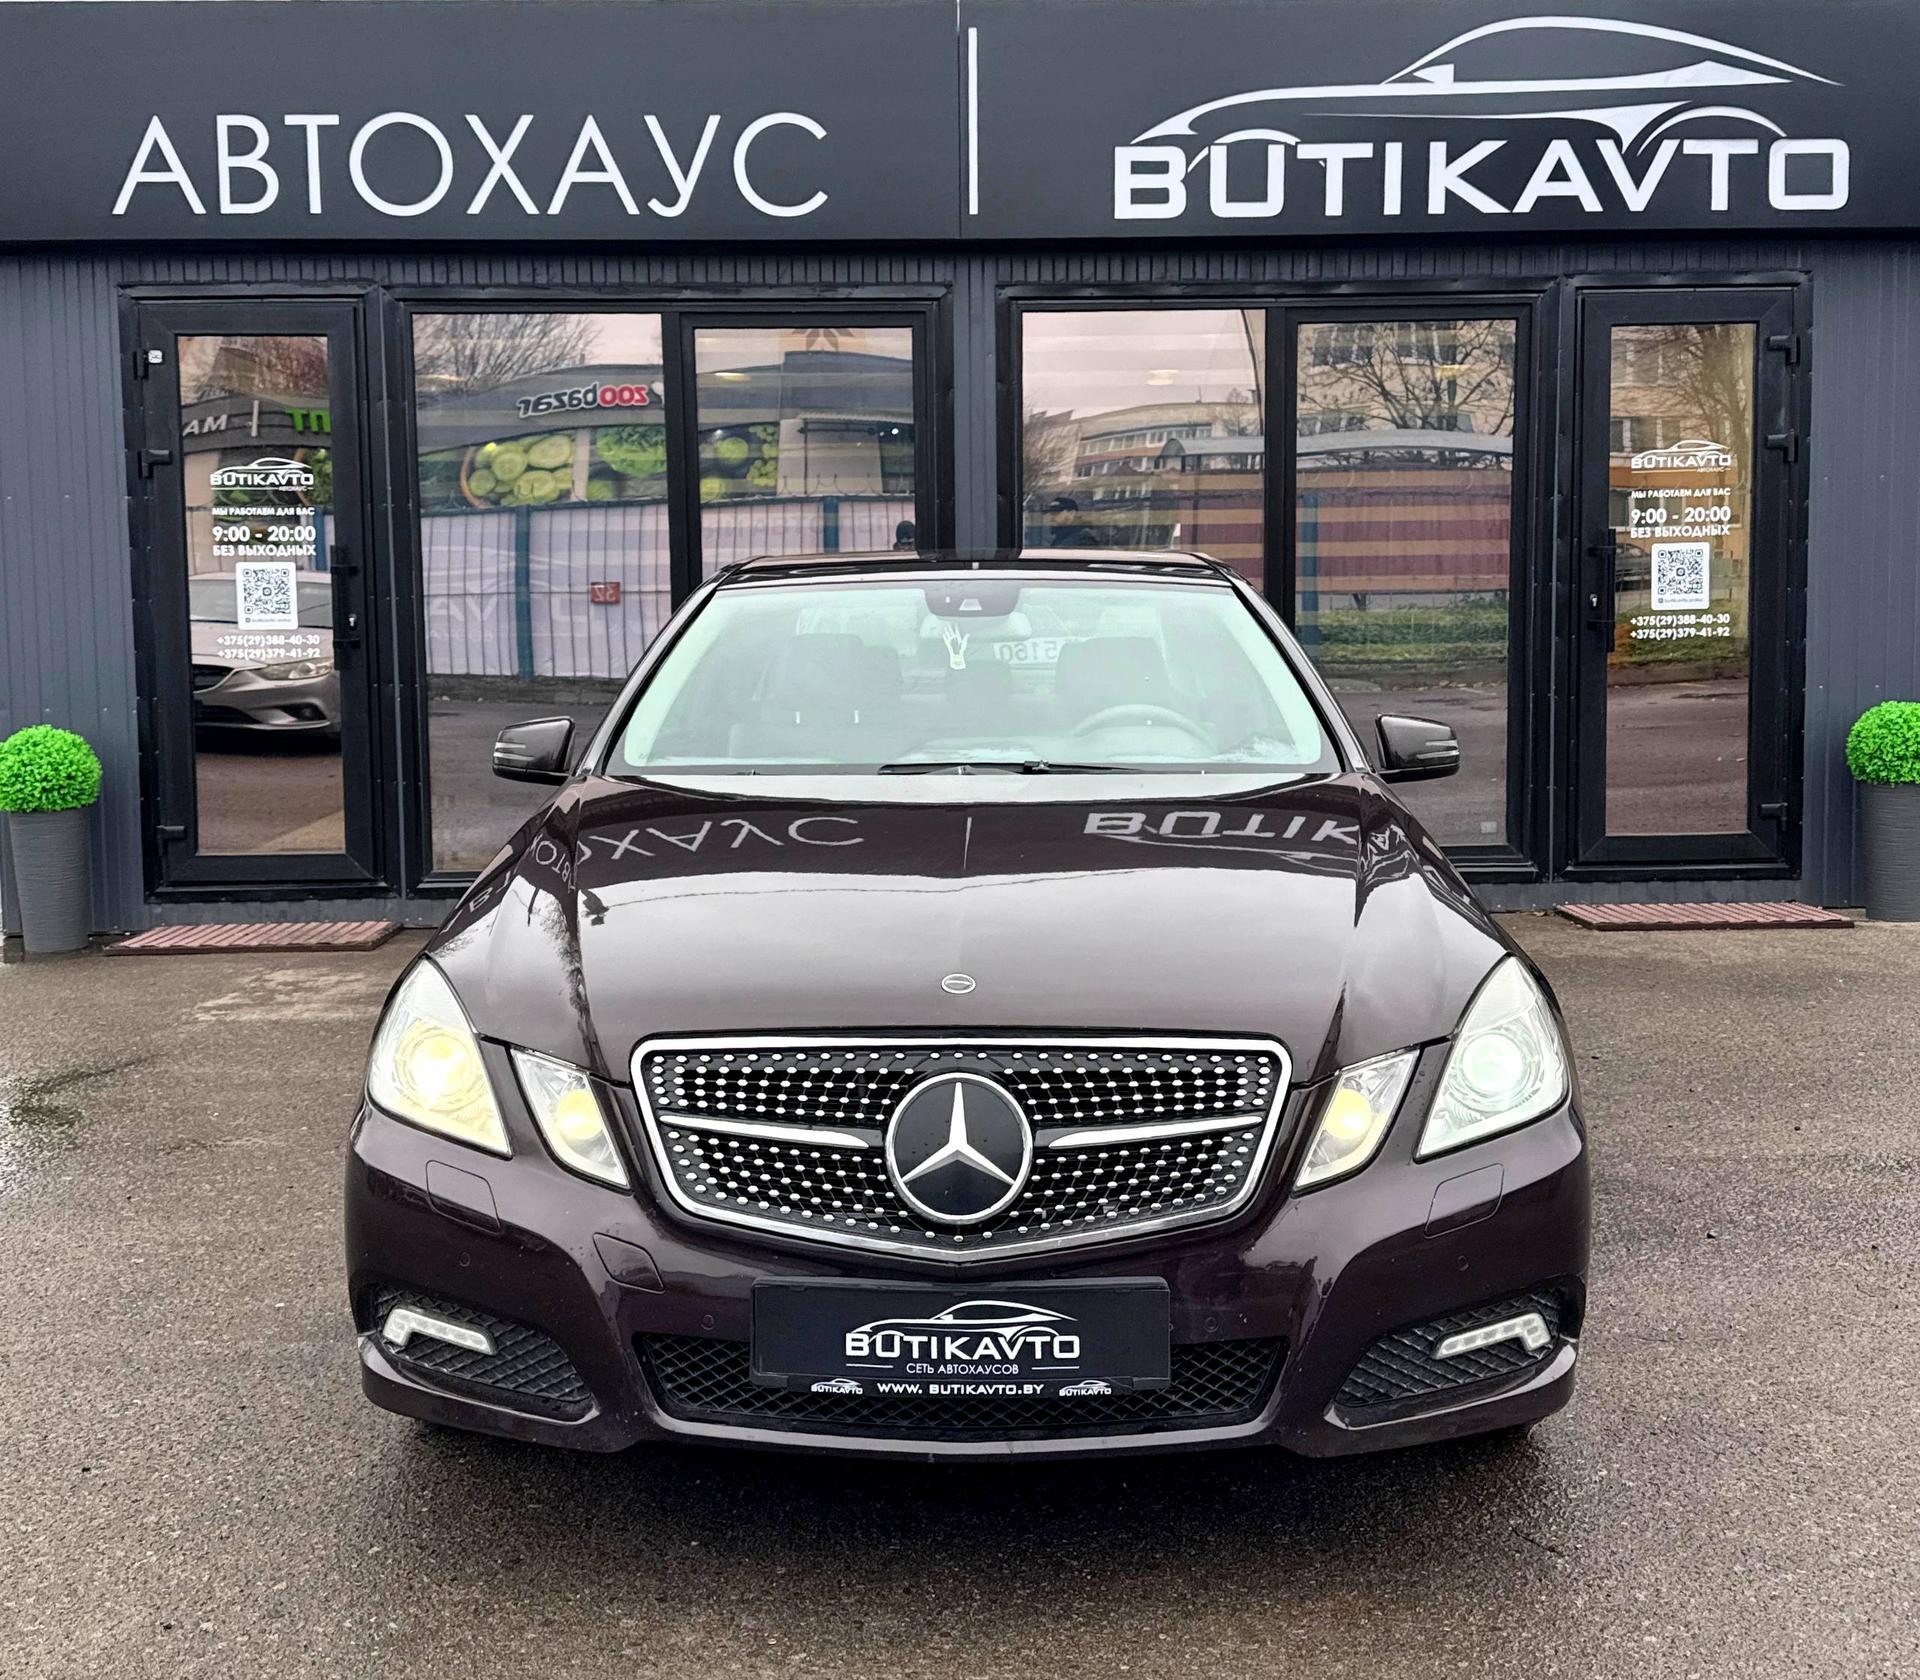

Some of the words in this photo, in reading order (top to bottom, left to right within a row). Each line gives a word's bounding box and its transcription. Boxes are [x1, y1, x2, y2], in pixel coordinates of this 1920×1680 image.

[112, 112, 829, 218] АВТОХАУС
[1113, 137, 1850, 220] BUTIKAVTO
[1631, 454, 1732, 469] BUTIKAVTO
[209, 472, 314, 486] BUTIKAVTO
[1631, 490, 1646, 499] МЫ
[1648, 488, 1692, 498] РАБОТАЕМ
[1694, 488, 1711, 498] ДЛЯ
[1713, 487, 1731, 496] ВАС
[211, 507, 228, 516] МЫ
[229, 507, 275, 516] РАБОТАЕМ
[276, 507, 294, 517] ДЛЯ
[296, 507, 315, 516] ВАС
[1631, 508, 1667, 524] 9:00
[1684, 506, 1731, 522] 20:00
[212, 526, 250, 542] 9:00
[267, 526, 316, 542] 20:00
[1631, 527, 1652, 539] БЕЗ
[1654, 524, 1730, 537] ВЫХОДНЫХ
[213, 545, 235, 557] БЕЗ
[238, 544, 316, 557] ВЫХОДНЫХ
[1630, 613, 1730, 627] +375(29)388-40-30
[1630, 627, 1730, 640] +375(29)379-41-92
[217, 634, 320, 647] +375(29)388-40-30
[845, 1332, 1080, 1360] BUTIKAVTO
[906, 1363, 935, 1375] СЕТЬ
[937, 1363, 1019, 1375] АВТОХАУСОВ
[811, 1384, 863, 1395] BUTIKAVTO
[929, 1383, 1045, 1395] BUTIKAVTO.BY
[1058, 1386, 1112, 1397] BUTIKAVTO
